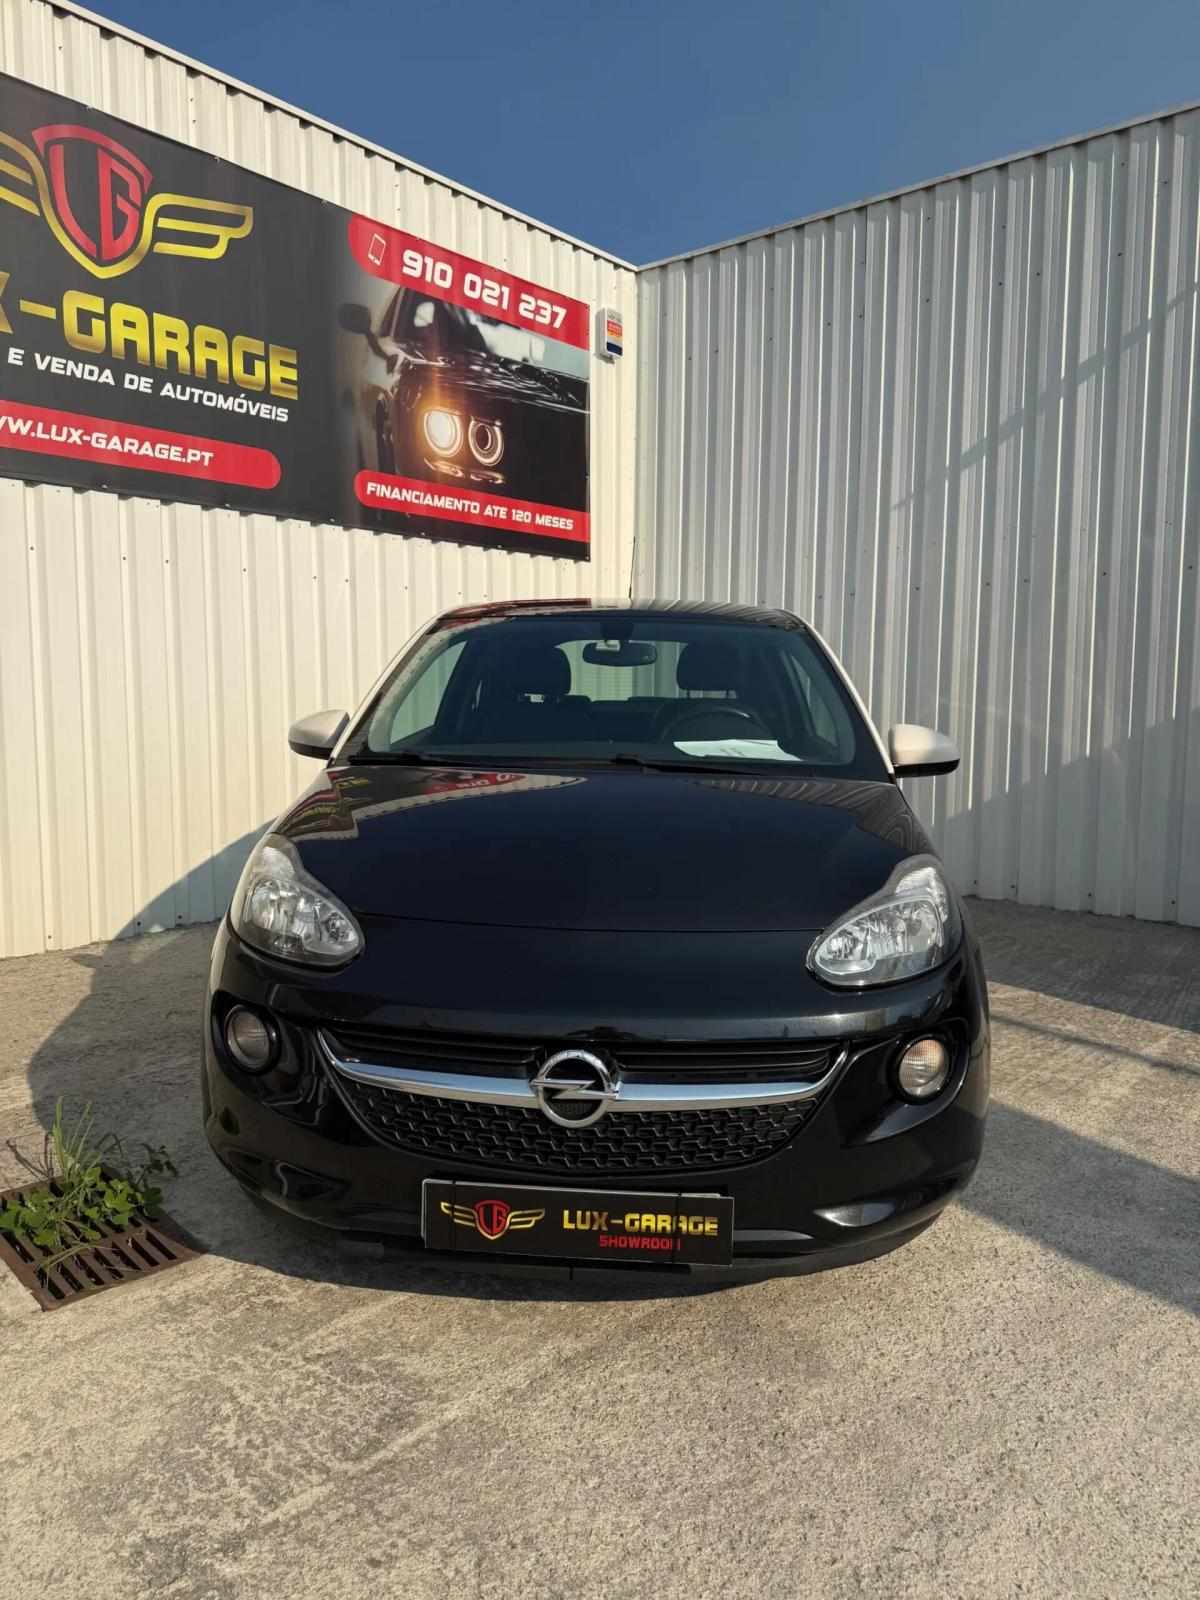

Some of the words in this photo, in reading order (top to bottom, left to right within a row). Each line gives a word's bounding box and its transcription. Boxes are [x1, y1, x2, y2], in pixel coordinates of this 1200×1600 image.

[402, 249, 453, 288] 910
[464, 274, 510, 309] 021
[518, 294, 567, 329] 237
[7, 347, 25, 366] E
[34, 353, 115, 386] VENDA
[124, 373, 154, 394] DE
[160, 382, 289, 422] AUTOMÓVEIS
[366, 481, 480, 514] FINANCIAMENTO
[483, 504, 507, 519] ATE
[511, 508, 532, 523] 120
[535, 513, 574, 530] MESES
[563, 1210, 719, 1236] LUX-GARAGE
